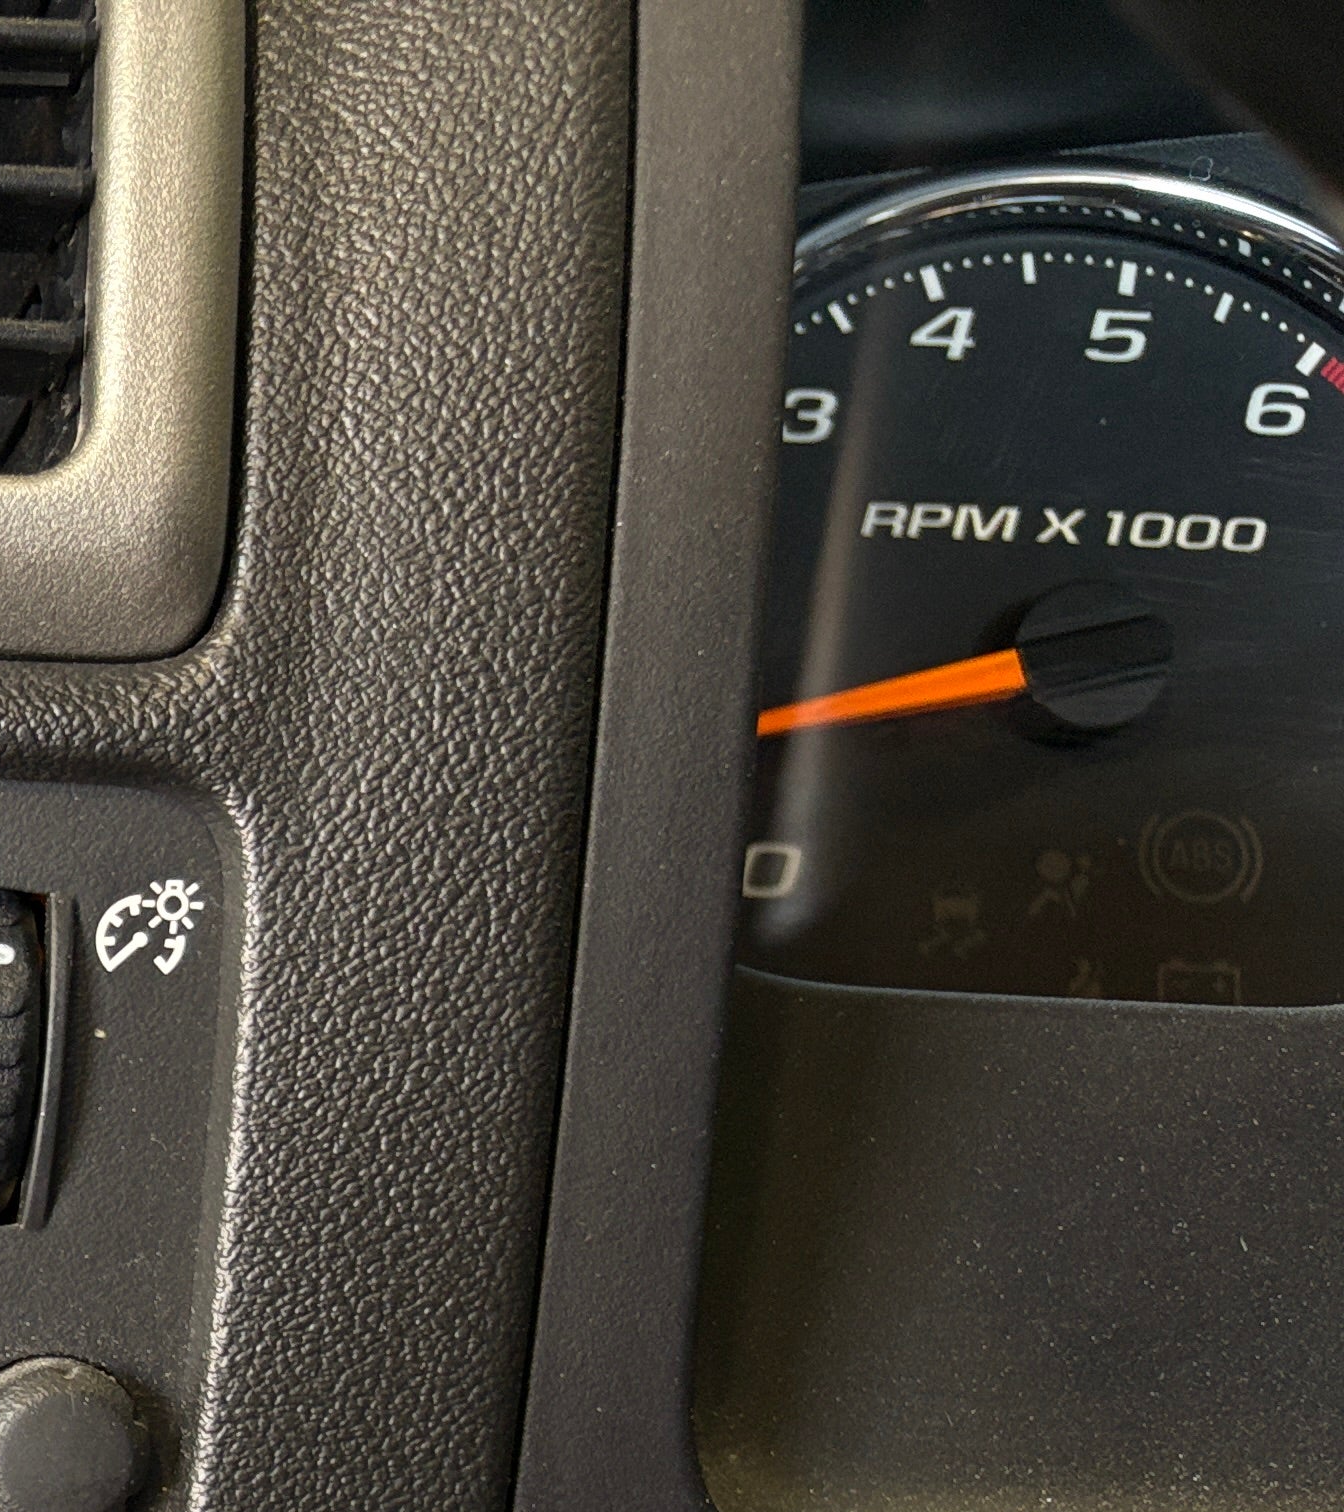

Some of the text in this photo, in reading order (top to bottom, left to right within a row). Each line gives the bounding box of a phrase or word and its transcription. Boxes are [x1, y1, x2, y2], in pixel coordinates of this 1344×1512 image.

[910, 306, 976, 361] 4
[1084, 308, 1152, 363] 5
[782, 388, 838, 444] 3
[1245, 382, 1310, 437] 6
[860, 501, 1268, 553] RPM X 1000
